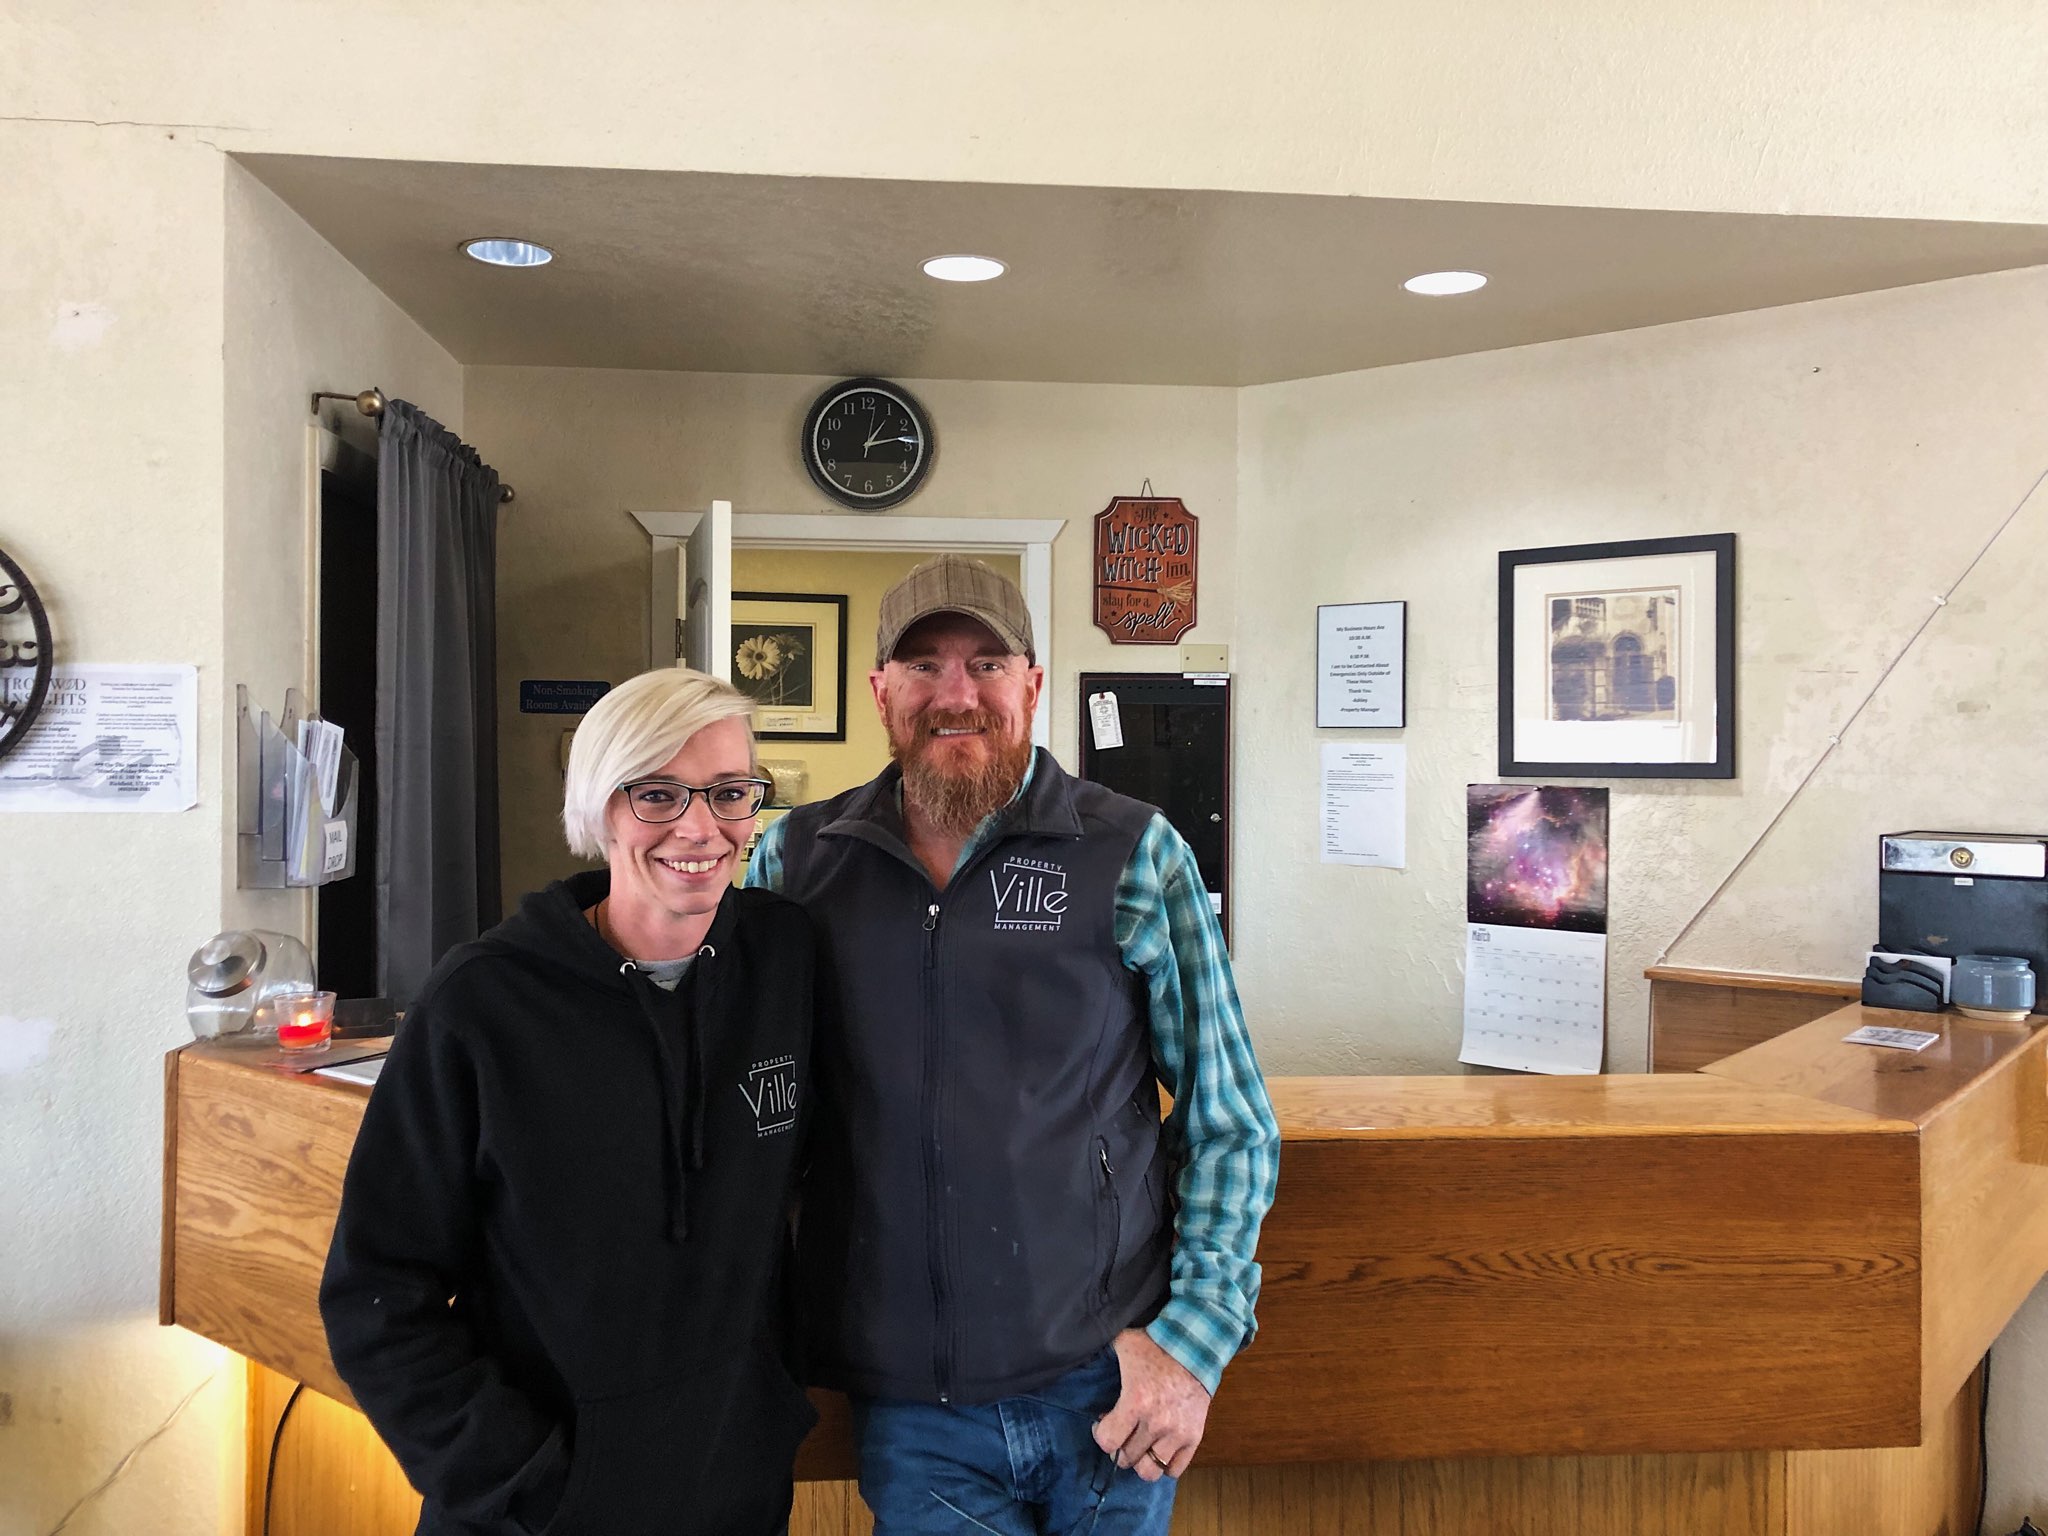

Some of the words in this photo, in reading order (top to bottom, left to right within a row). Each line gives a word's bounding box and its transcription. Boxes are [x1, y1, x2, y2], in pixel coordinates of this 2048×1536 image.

[844, 403, 855, 414] 11
[861, 397, 875, 409] 12
[887, 404, 891, 415] 1
[827, 419, 841, 430] 10
[900, 420, 908, 431] 2
[822, 438, 830, 450] 9
[828, 459, 836, 471] 8
[900, 461, 907, 472] 4
[844, 475, 852, 486] 7
[865, 480, 873, 492] 6
[886, 476, 894, 487] 5
[1106, 522, 1190, 556] WICKED
[1102, 593, 1123, 609] stay
[1126, 594, 1140, 607] for
[1143, 599, 1150, 608] a
[1110, 601, 1182, 636] spell
[533, 685, 599, 697] Non-Smoking
[526, 700, 559, 710] Rooms
[329, 830, 342, 844] MAIL
[328, 854, 343, 870] DROP
[1010, 856, 1062, 871] PROPERTY
[990, 869, 1069, 914] Ville
[994, 923, 1060, 931] MANAGEMENT
[1472, 930, 1491, 942] March
[738, 1073, 797, 1118] Ville
[757, 1123, 794, 1138] MANAGEM
